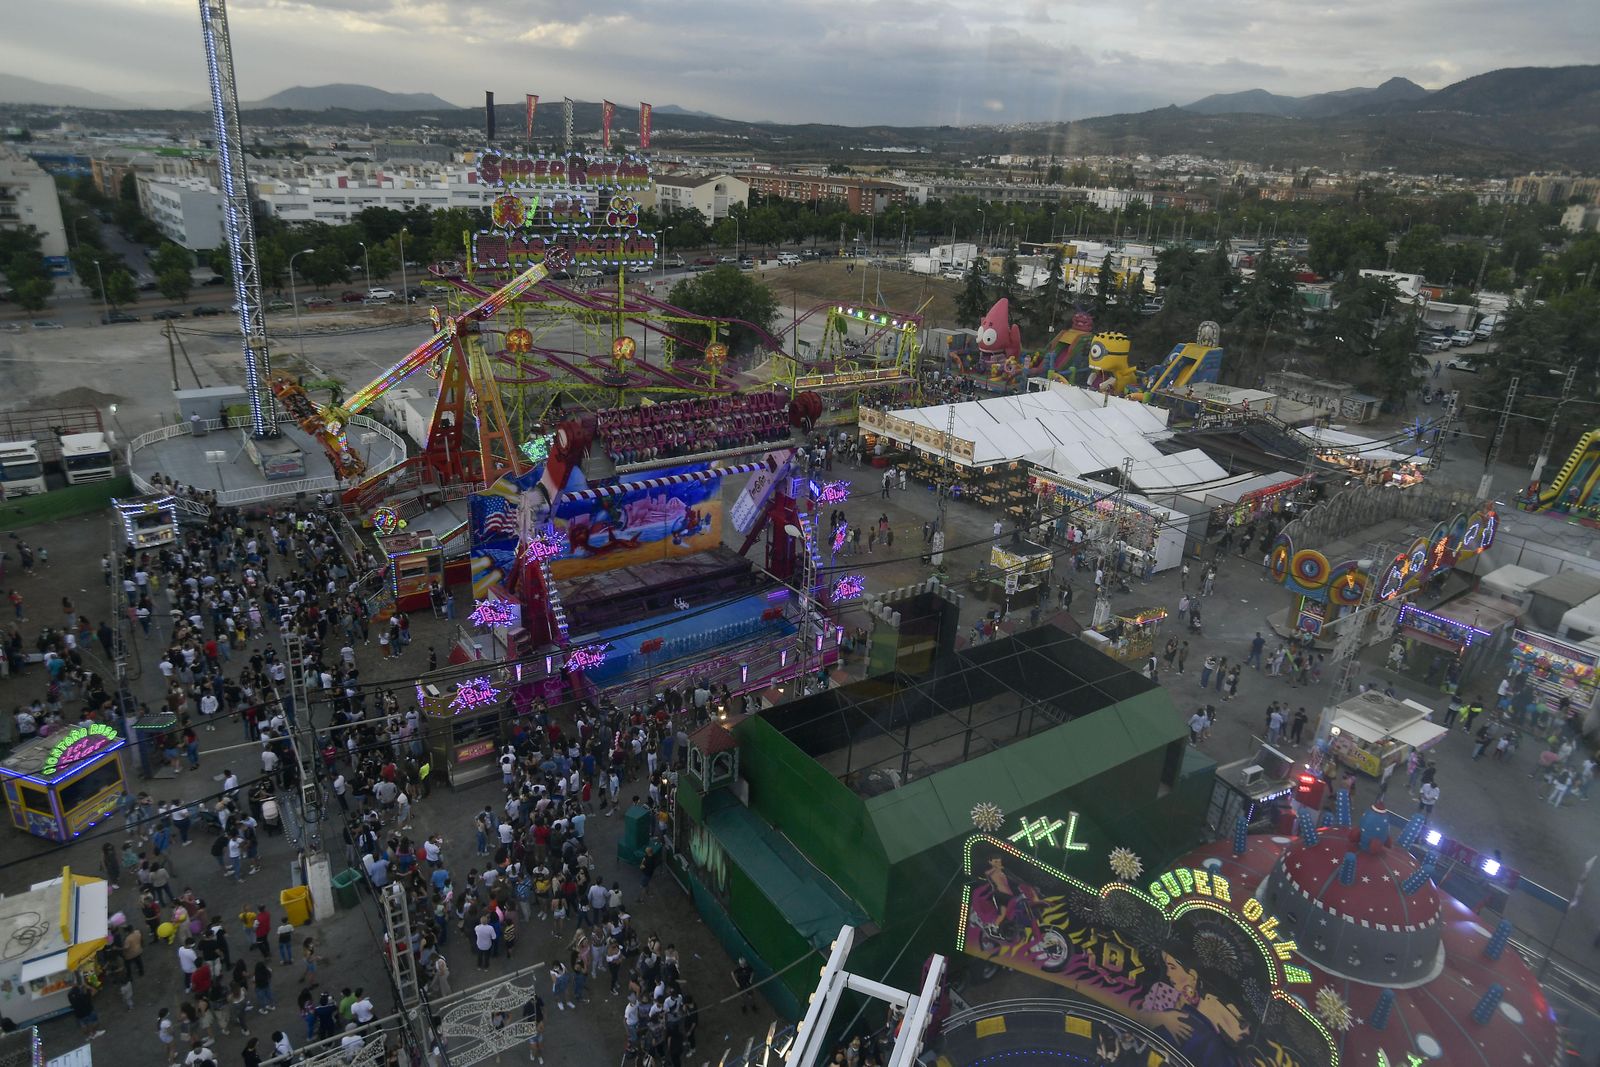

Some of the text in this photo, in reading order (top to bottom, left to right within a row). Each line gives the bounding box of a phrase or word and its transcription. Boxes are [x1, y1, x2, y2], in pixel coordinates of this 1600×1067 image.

[480, 153, 566, 184] SUPER
[1007, 811, 1089, 850] XXL
[1149, 867, 1232, 907] SUPER
